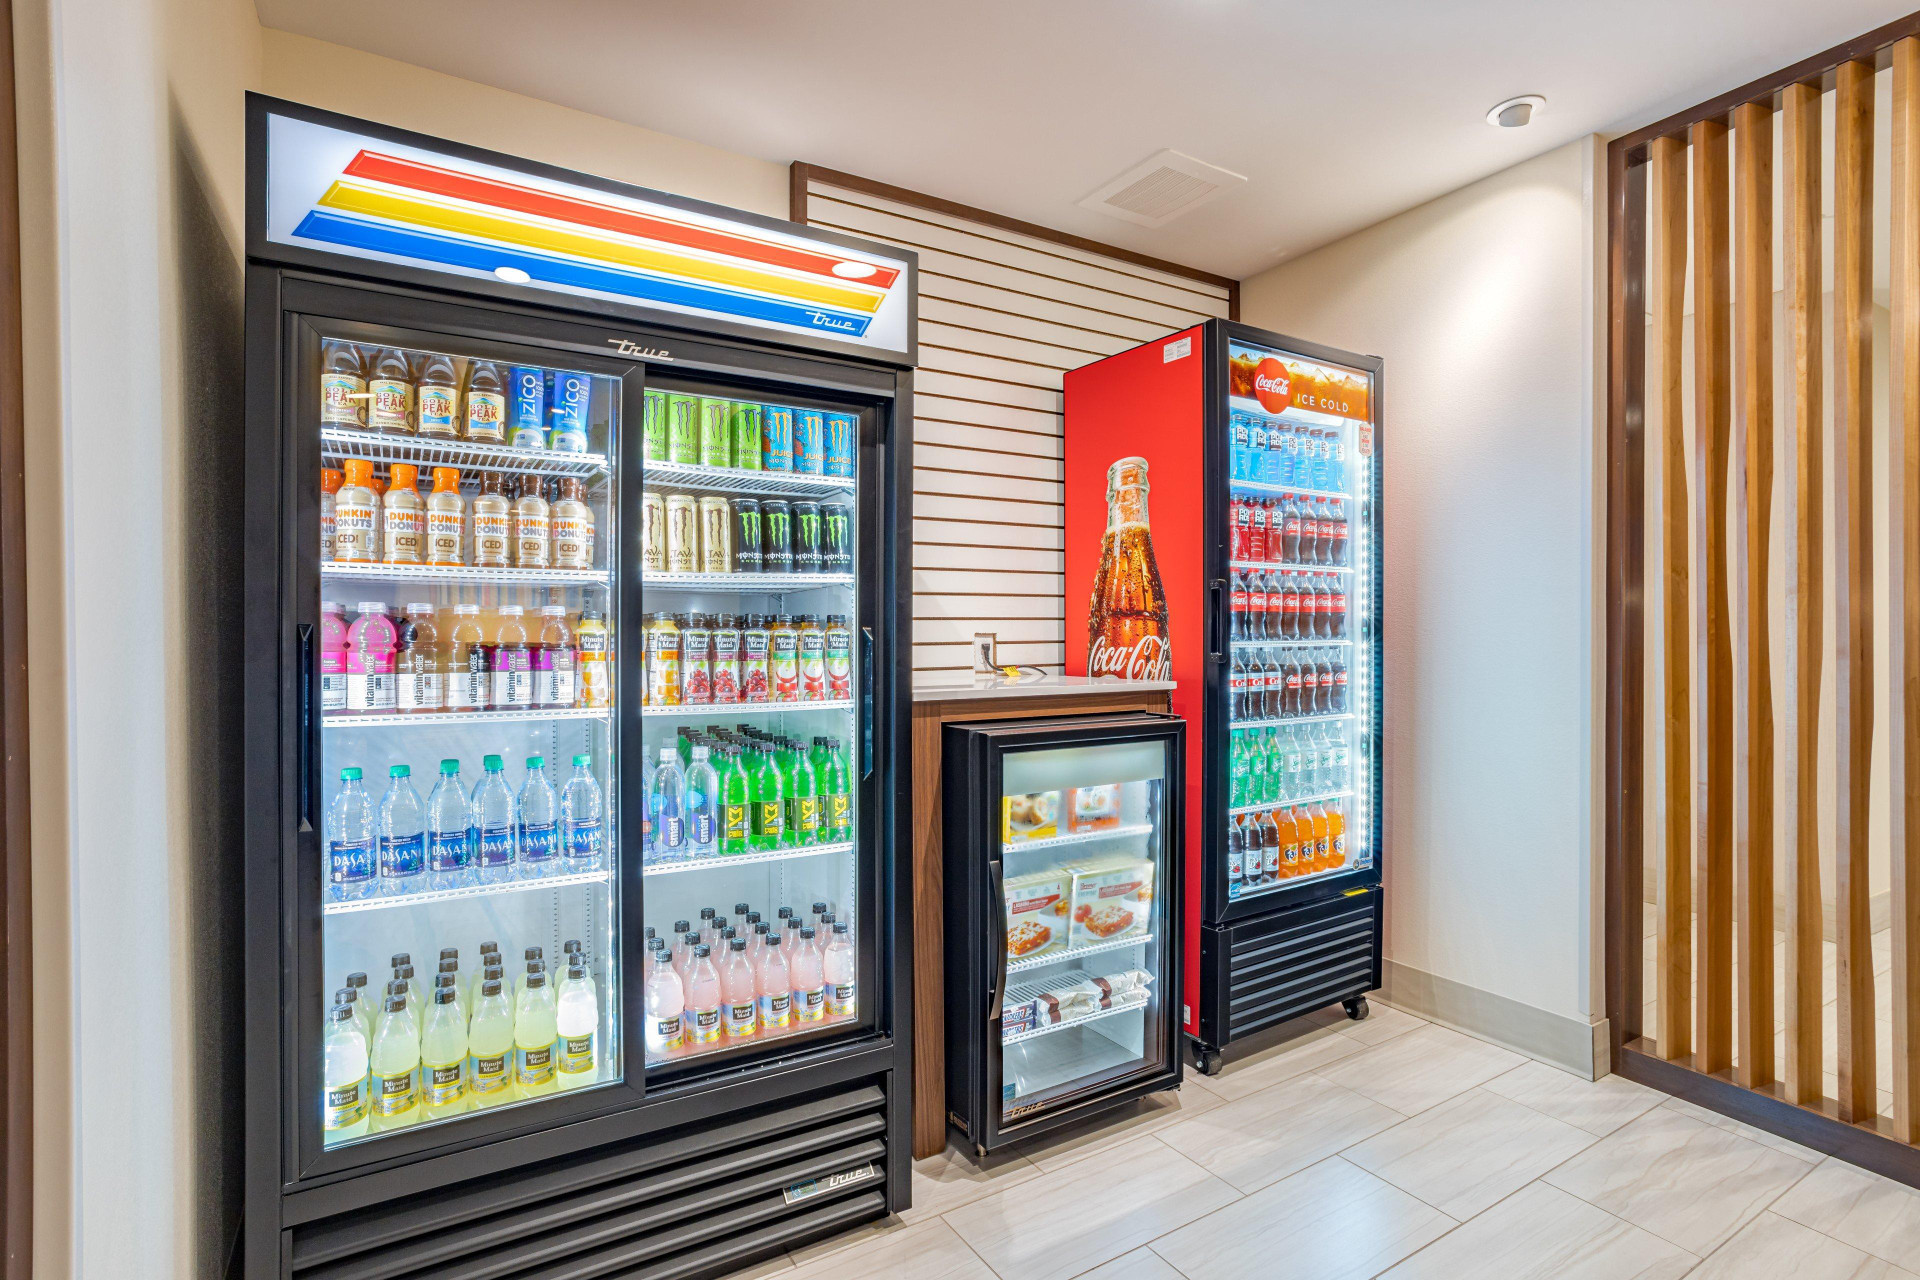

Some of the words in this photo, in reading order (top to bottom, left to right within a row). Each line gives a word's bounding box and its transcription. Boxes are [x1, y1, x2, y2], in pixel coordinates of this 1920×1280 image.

[806, 312, 857, 331] true
[608, 338, 674, 361] true
[1256, 374, 1290, 395] Coca-Cola
[376, 398, 406, 409] PEAK
[1298, 393, 1315, 406] ICE
[1321, 399, 1349, 413] COLD
[423, 404, 451, 414] PEAK
[470, 409, 497, 420] PEAK
[668, 817, 679, 846] smart
[699, 814, 709, 843] smart
[569, 1040, 589, 1048] Minute
[572, 1045, 586, 1053] Maid
[528, 1052, 549, 1060] Minute
[480, 1060, 502, 1068] Minute
[436, 1068, 458, 1078] Minute
[438, 1074, 455, 1082] Maid
[384, 1078, 409, 1088] Minute
[387, 1084, 406, 1092] Maid
[331, 1090, 356, 1100] Minute
[334, 1096, 353, 1105] Maid
